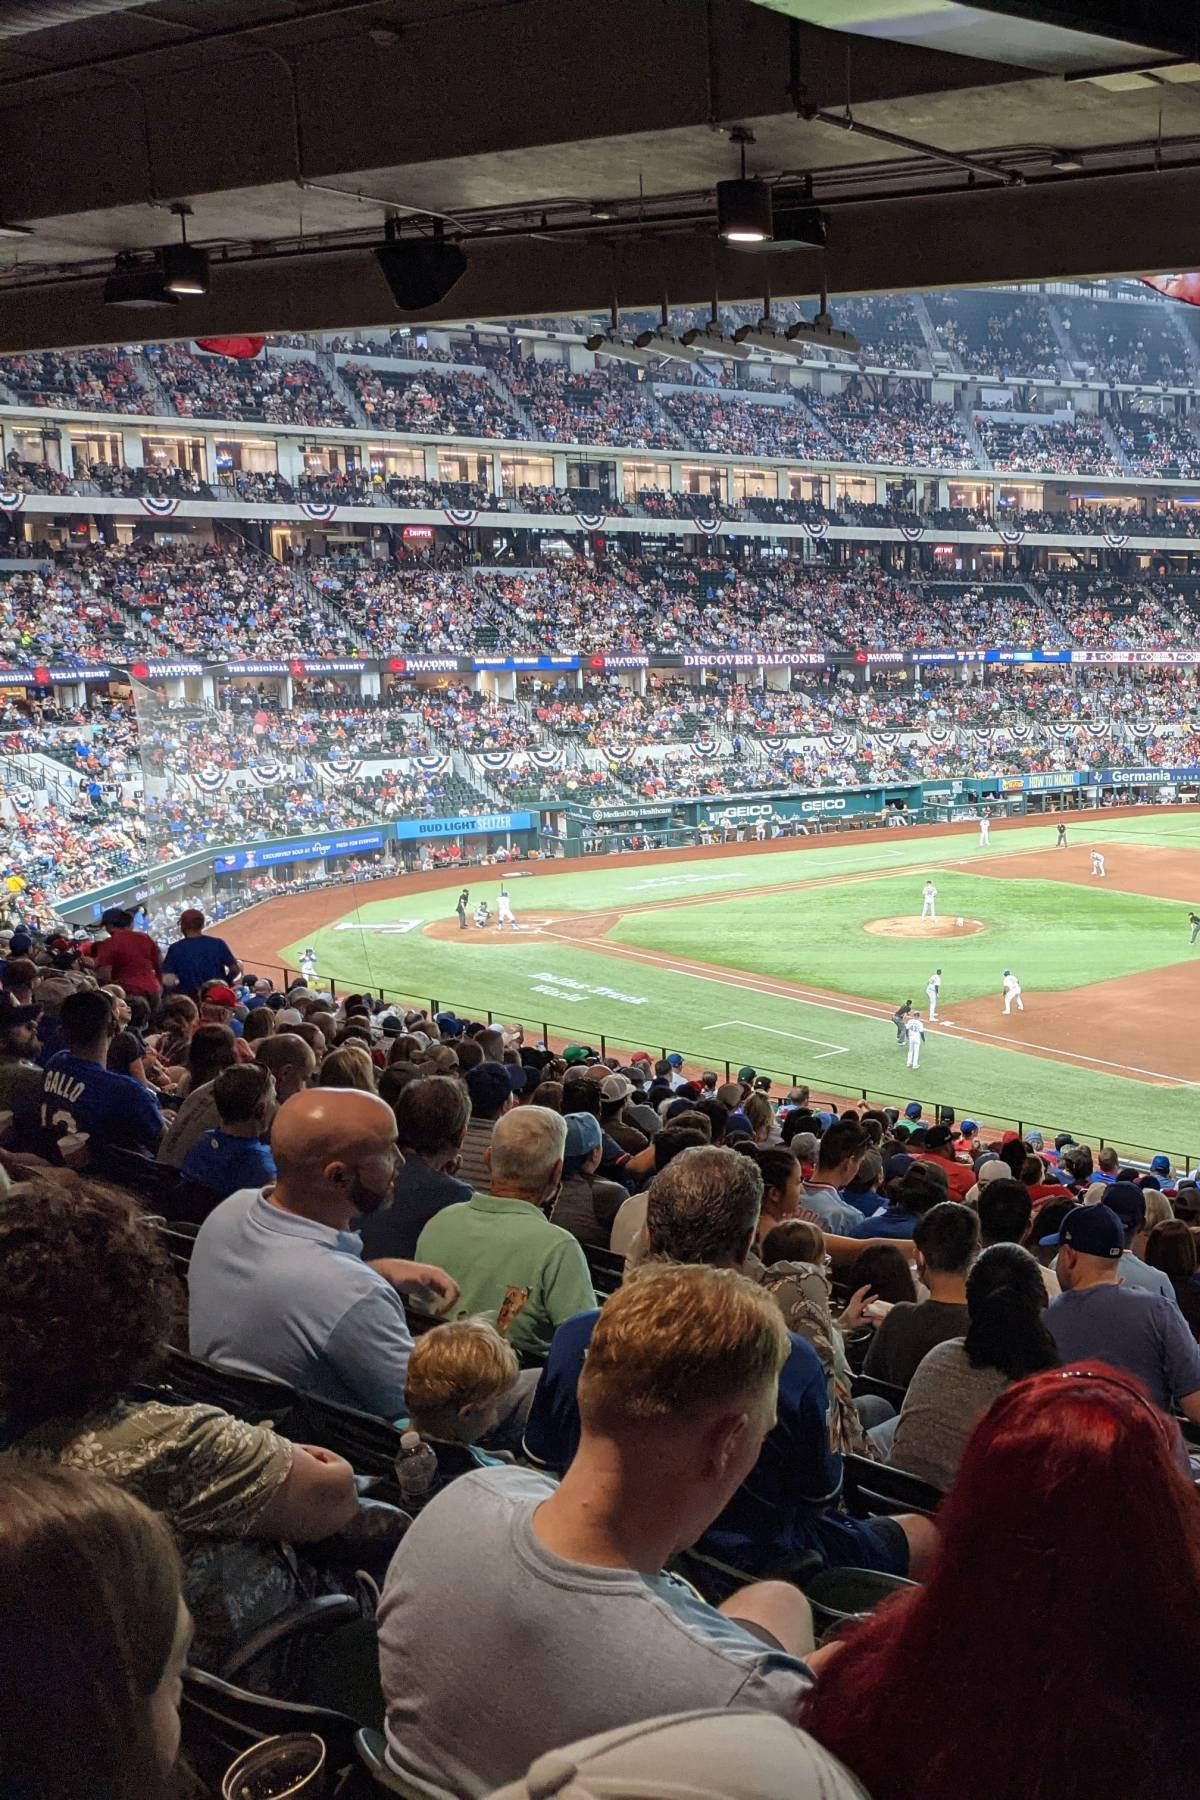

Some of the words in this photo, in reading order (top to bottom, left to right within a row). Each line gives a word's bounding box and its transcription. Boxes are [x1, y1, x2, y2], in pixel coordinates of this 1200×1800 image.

[406, 660, 458, 669] BALCONES
[604, 657, 649, 665] BALCONES
[684, 654, 753, 665] DISCOVER
[757, 654, 826, 664] BALCONES
[149, 664, 202, 674] BALCONES
[1030, 775, 1044, 787] HOW
[1045, 775, 1053, 785] TO
[1112, 770, 1171, 782] Germania
[802, 799, 846, 811] GEICO
[603, 810, 627, 818] Medical
[627, 809, 639, 817] City
[726, 805, 772, 817] GEICO
[419, 824, 442, 833] BUD
[445, 821, 477, 831] LIGHT
[477, 815, 511, 829] SELTZER
[262, 851, 291, 860] EXCLUSIVELY
[44, 1070, 86, 1103] GALLO
